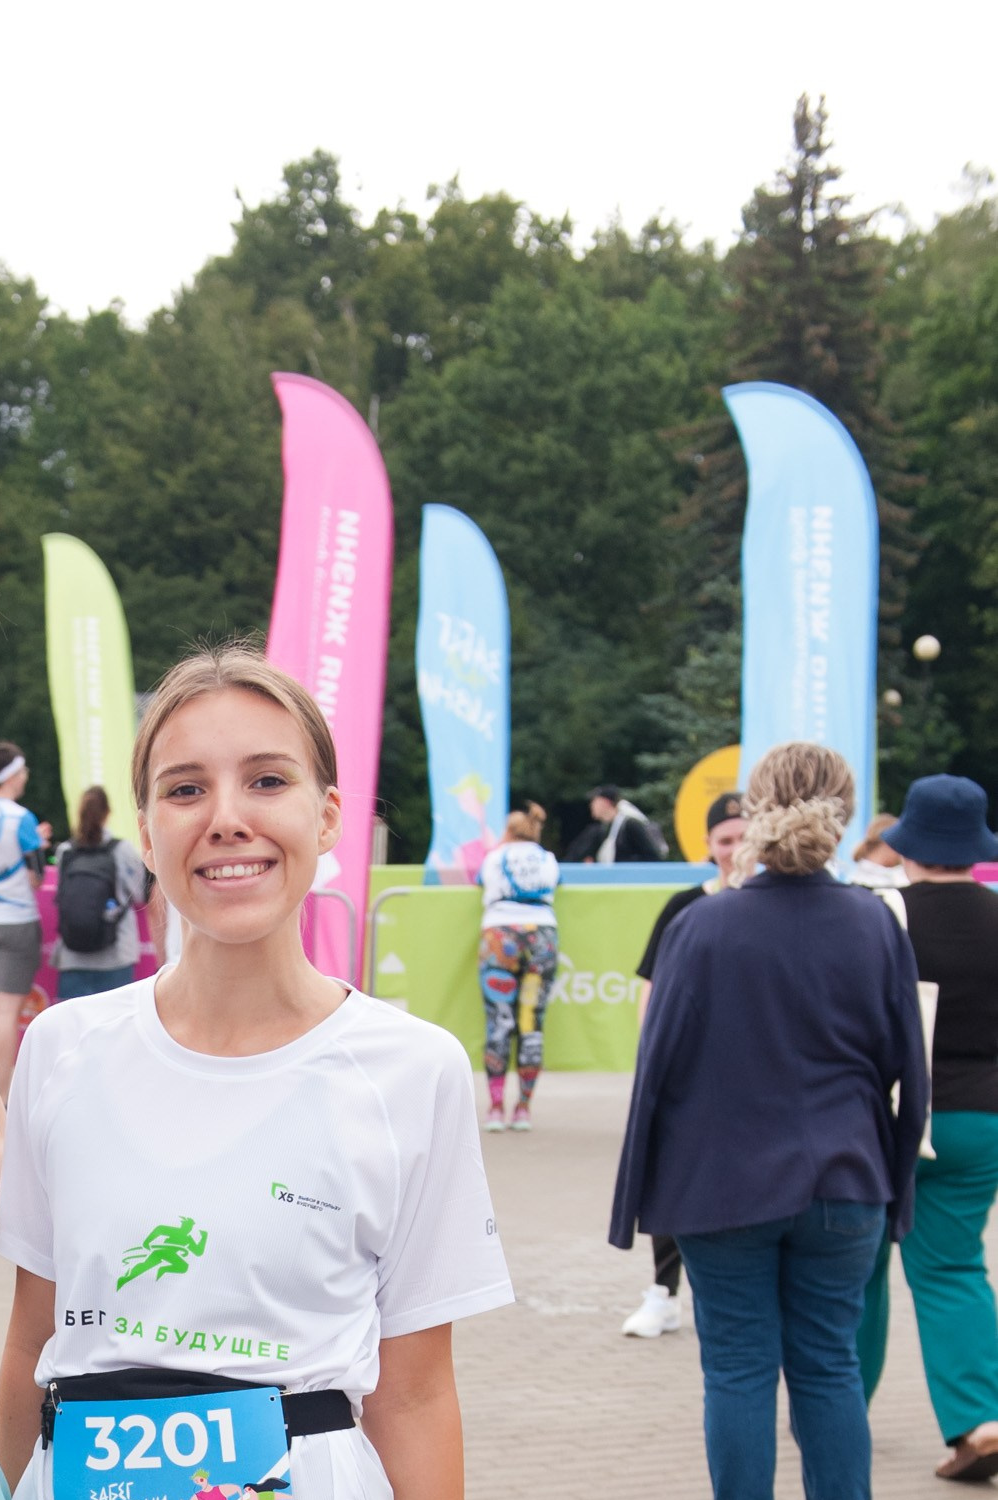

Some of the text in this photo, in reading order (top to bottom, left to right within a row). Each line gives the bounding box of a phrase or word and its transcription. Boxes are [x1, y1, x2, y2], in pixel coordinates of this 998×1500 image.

[114, 1317, 144, 1338] ЗА
[155, 1325, 290, 1361] БУДУЩЕЕ
[85, 1408, 237, 1471] 3201
